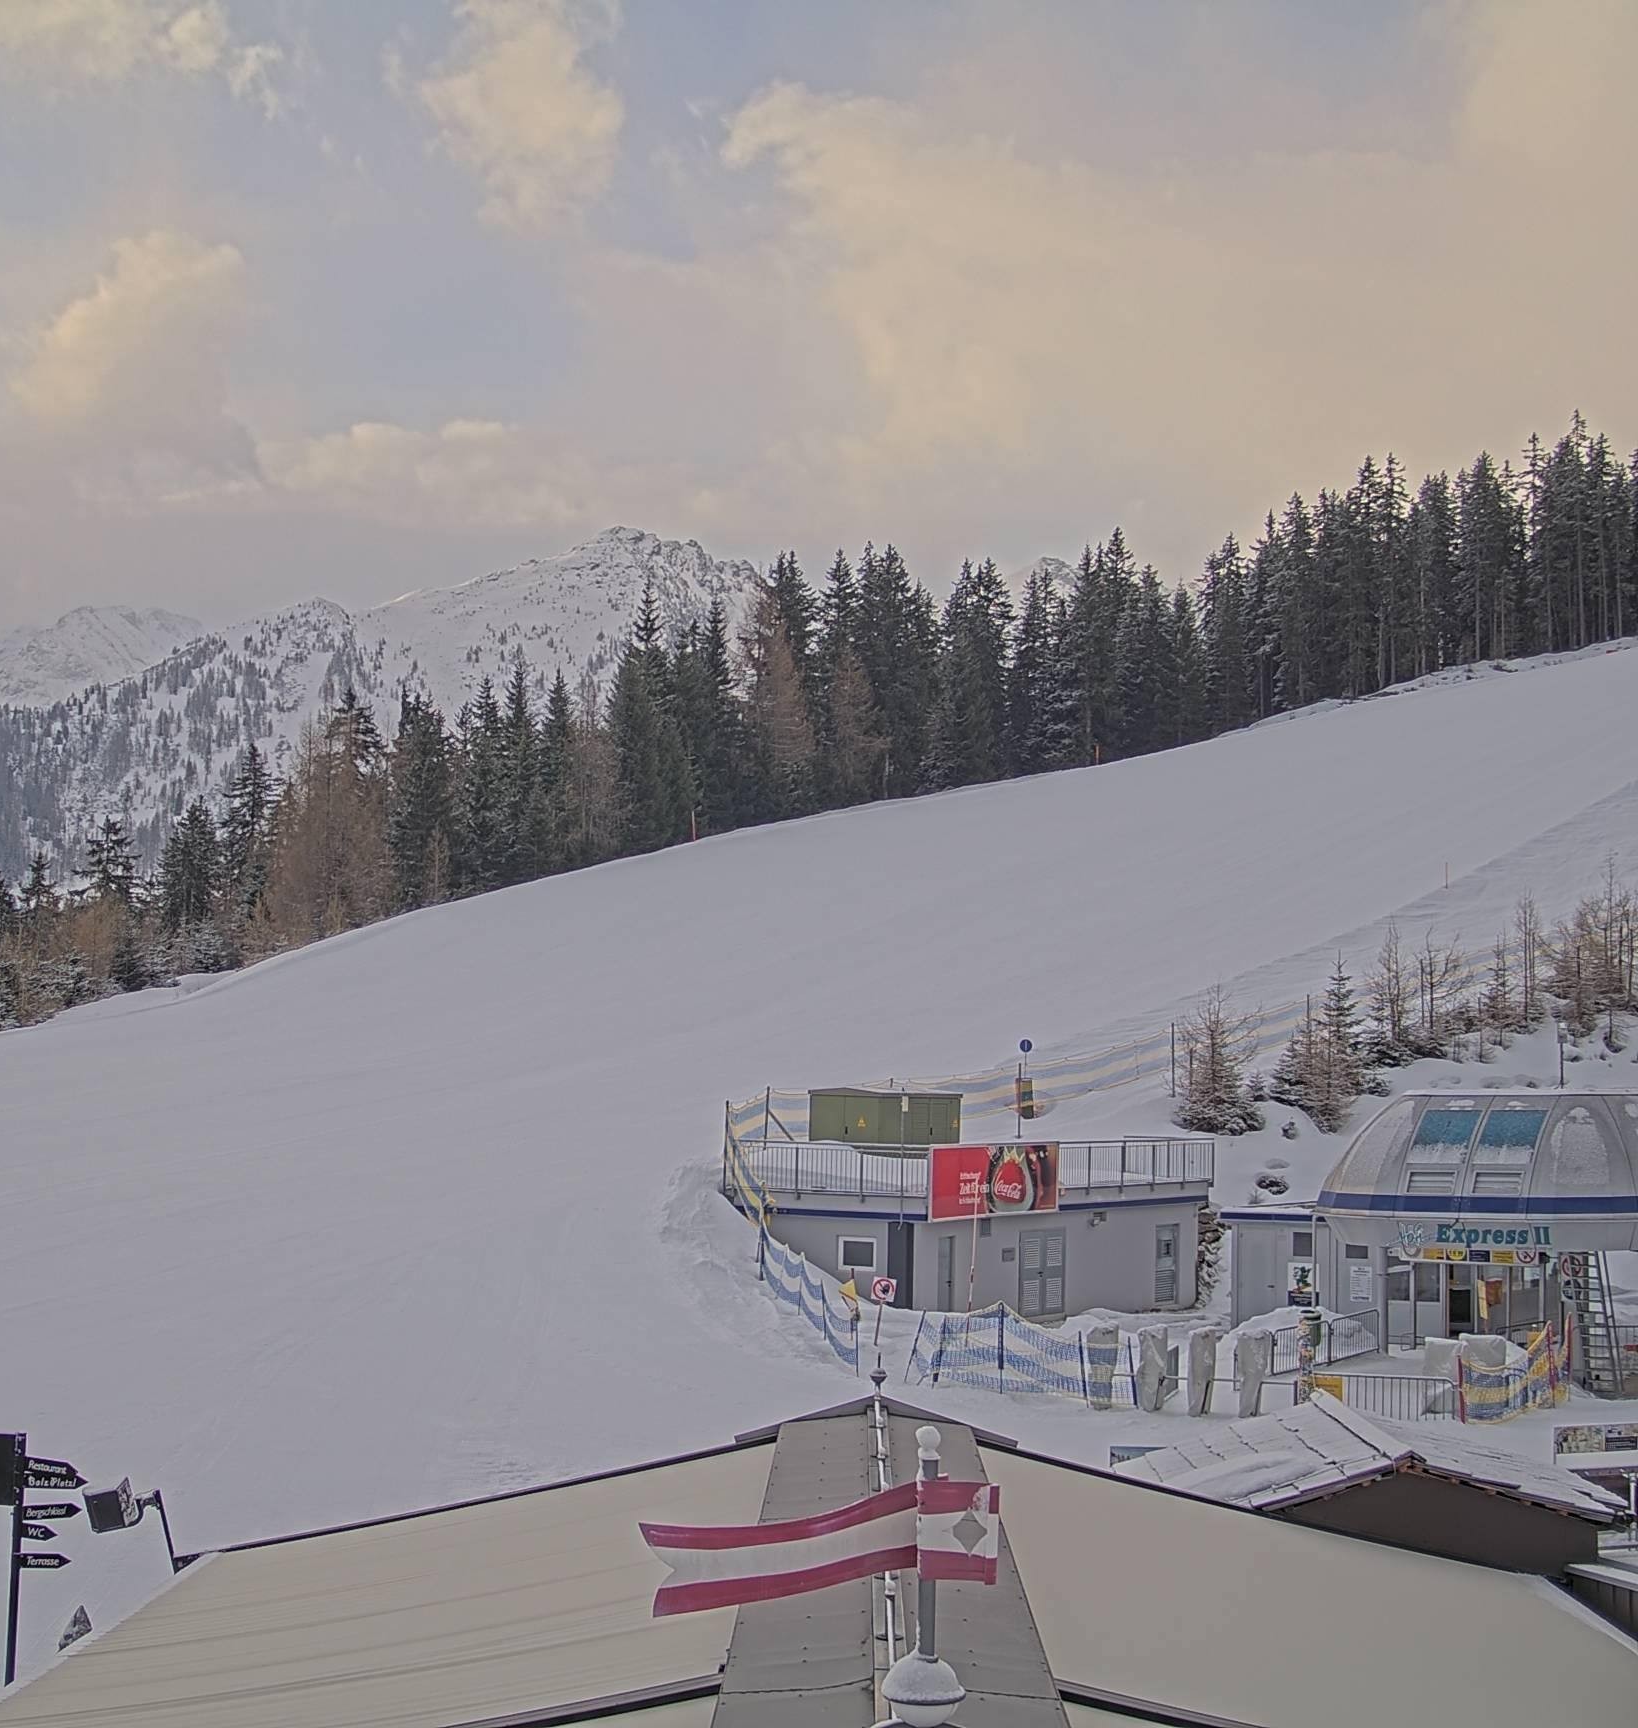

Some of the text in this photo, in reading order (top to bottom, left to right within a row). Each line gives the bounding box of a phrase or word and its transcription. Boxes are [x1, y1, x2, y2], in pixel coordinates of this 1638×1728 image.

[1436, 1223, 1529, 1249] Express
[28, 1459, 67, 1475] Restaurant
[27, 1527, 46, 1538] WC
[27, 1555, 60, 1566] Terrasse
